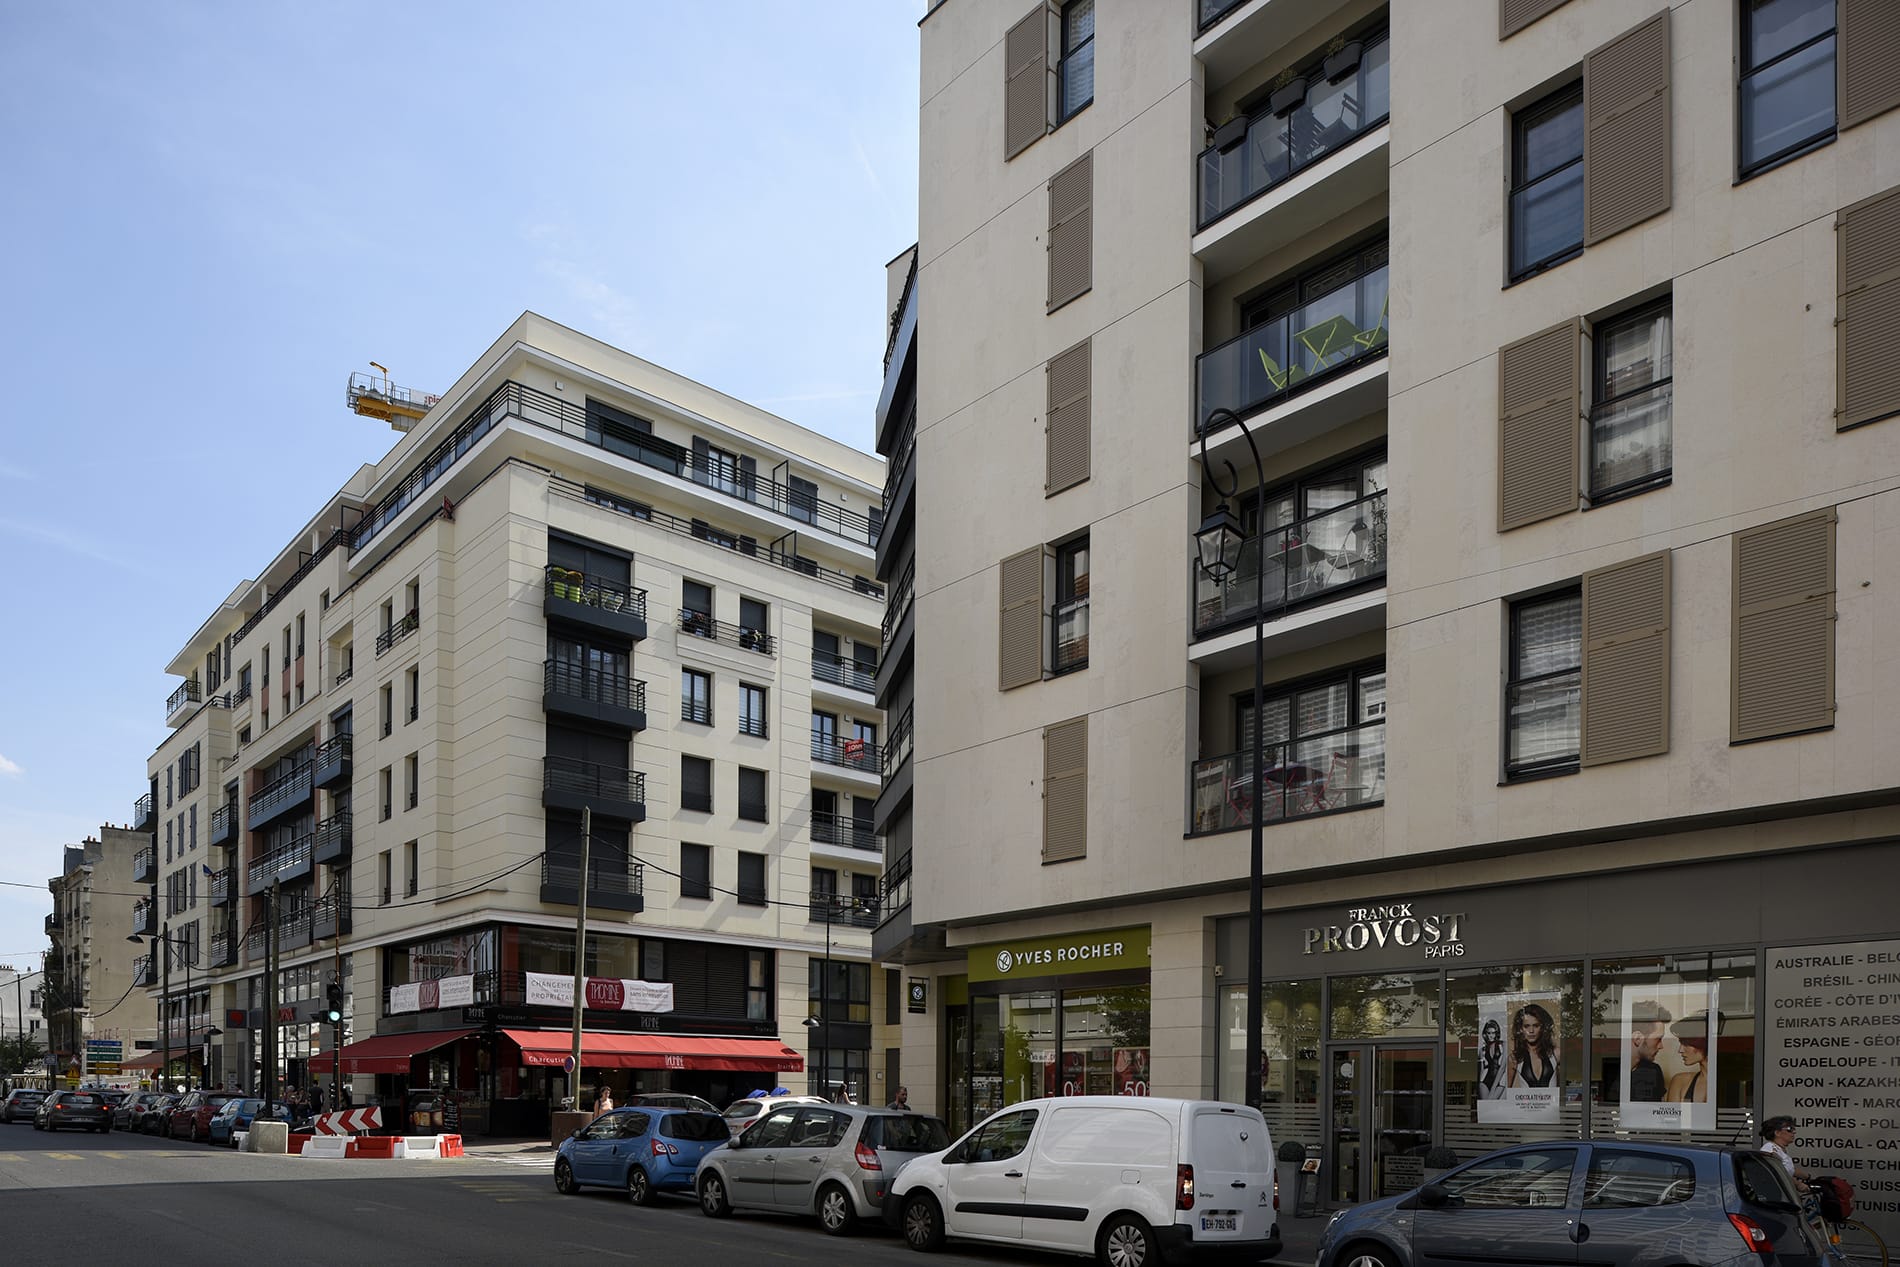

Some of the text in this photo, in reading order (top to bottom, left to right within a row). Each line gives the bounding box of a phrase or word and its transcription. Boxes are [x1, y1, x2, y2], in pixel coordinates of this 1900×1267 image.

[1349, 903, 1413, 922] FRANCK
[1302, 912, 1468, 955] PROVOST
[1015, 942, 1124, 966] YVES ROCHER
[1424, 944, 1465, 959] PARIS
[1775, 955, 1854, 969] AUSTRALIE
[531, 979, 576, 989] CHANGEMEN
[1803, 974, 1855, 988] BRÉSIL
[531, 992, 576, 1001] PROPRIÉTAI
[1774, 996, 1822, 1009] CORÉE
[1835, 994, 1875, 1006] CÔTE
[1879, 994, 1900, 1005] D'I
[1776, 1015, 1900, 1029] ÉMIRATS ARABES
[1784, 1037, 1850, 1048] ESPAGNE
[1779, 1057, 1877, 1068] GUADELOUPE
[1777, 1078, 1824, 1088] JAPON
[1837, 1077, 1900, 1088] KAZAKH
[1794, 1096, 1850, 1108] KOWEÏT
[1793, 1118, 1857, 1129] LIPPINES
[1794, 1138, 1864, 1149] ORTUGAL
[1792, 1158, 1900, 1171] PUBLIQUE TCH
